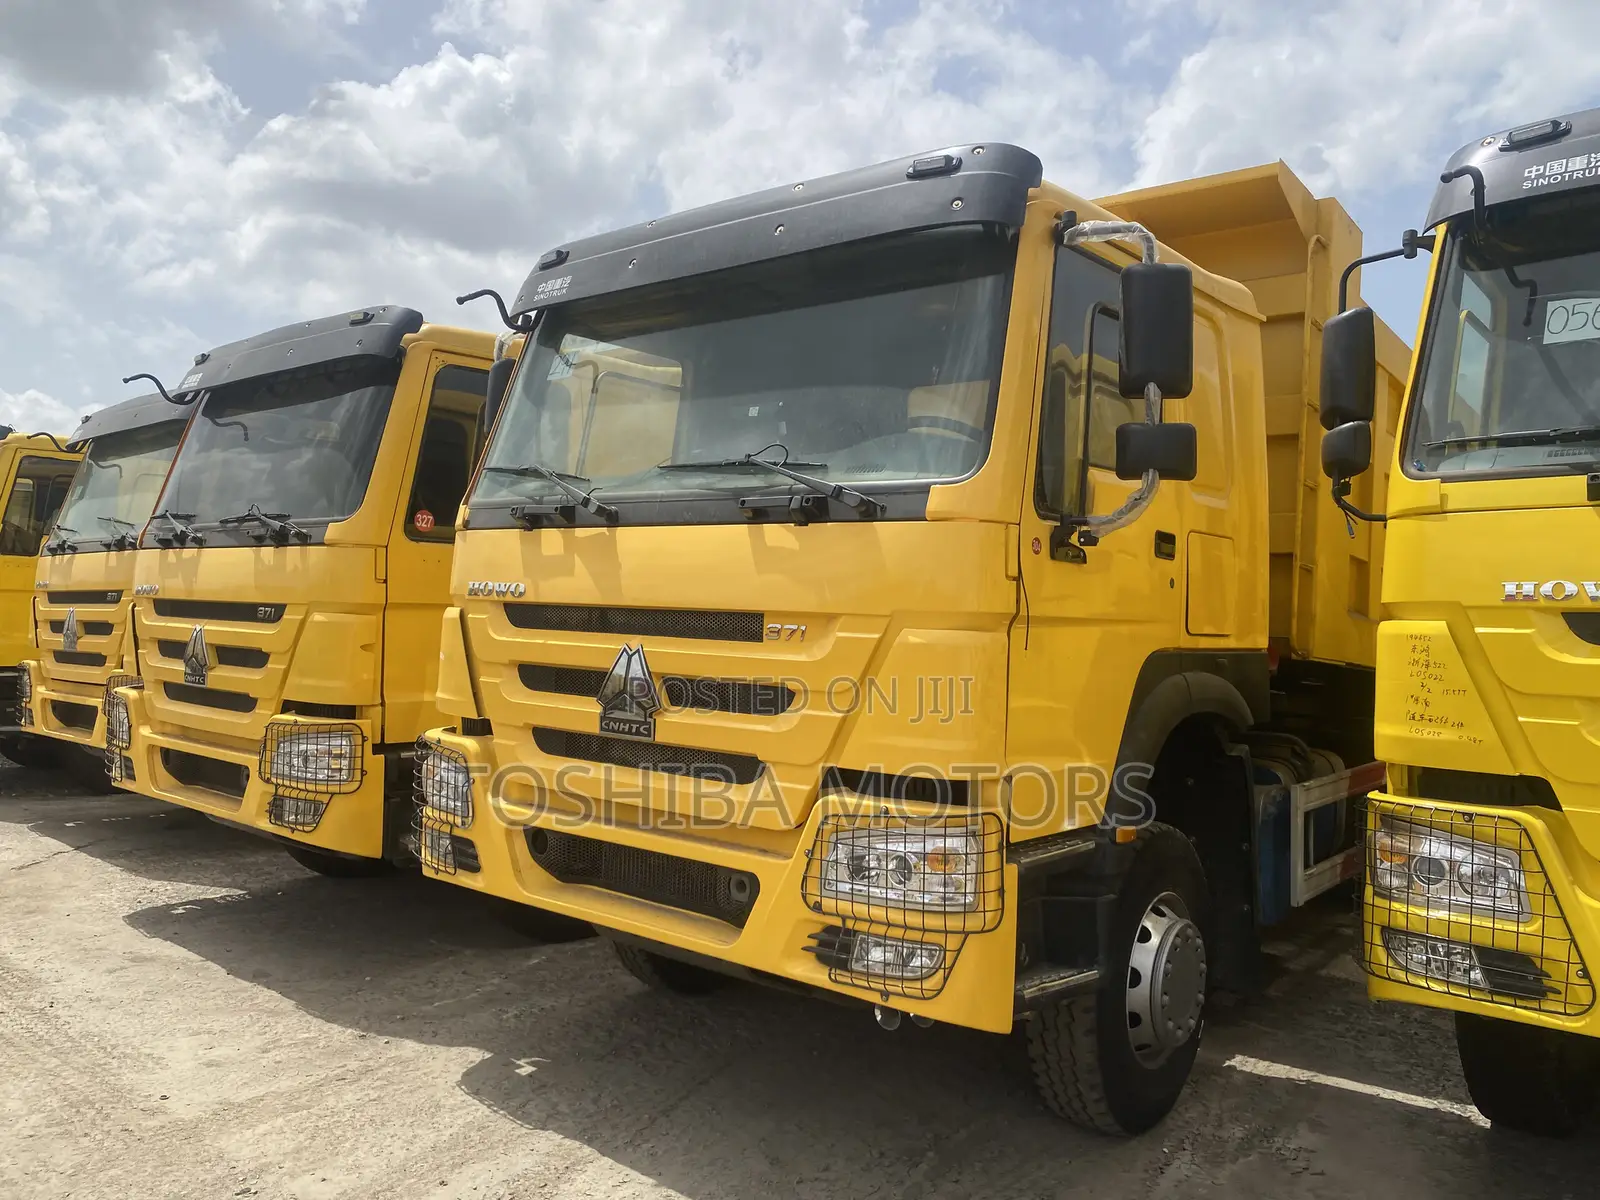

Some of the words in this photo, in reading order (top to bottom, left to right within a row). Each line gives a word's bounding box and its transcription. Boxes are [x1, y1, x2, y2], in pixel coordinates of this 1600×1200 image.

[1522, 167, 1600, 189] SINOTRU
[533, 287, 568, 302] SINOTRUK
[416, 513, 433, 528] 327
[467, 580, 526, 598] HOWO
[257, 606, 275, 619] 371
[765, 623, 808, 642] 371
[185, 674, 204, 683] CNHTC
[601, 720, 650, 735] CNHTC
